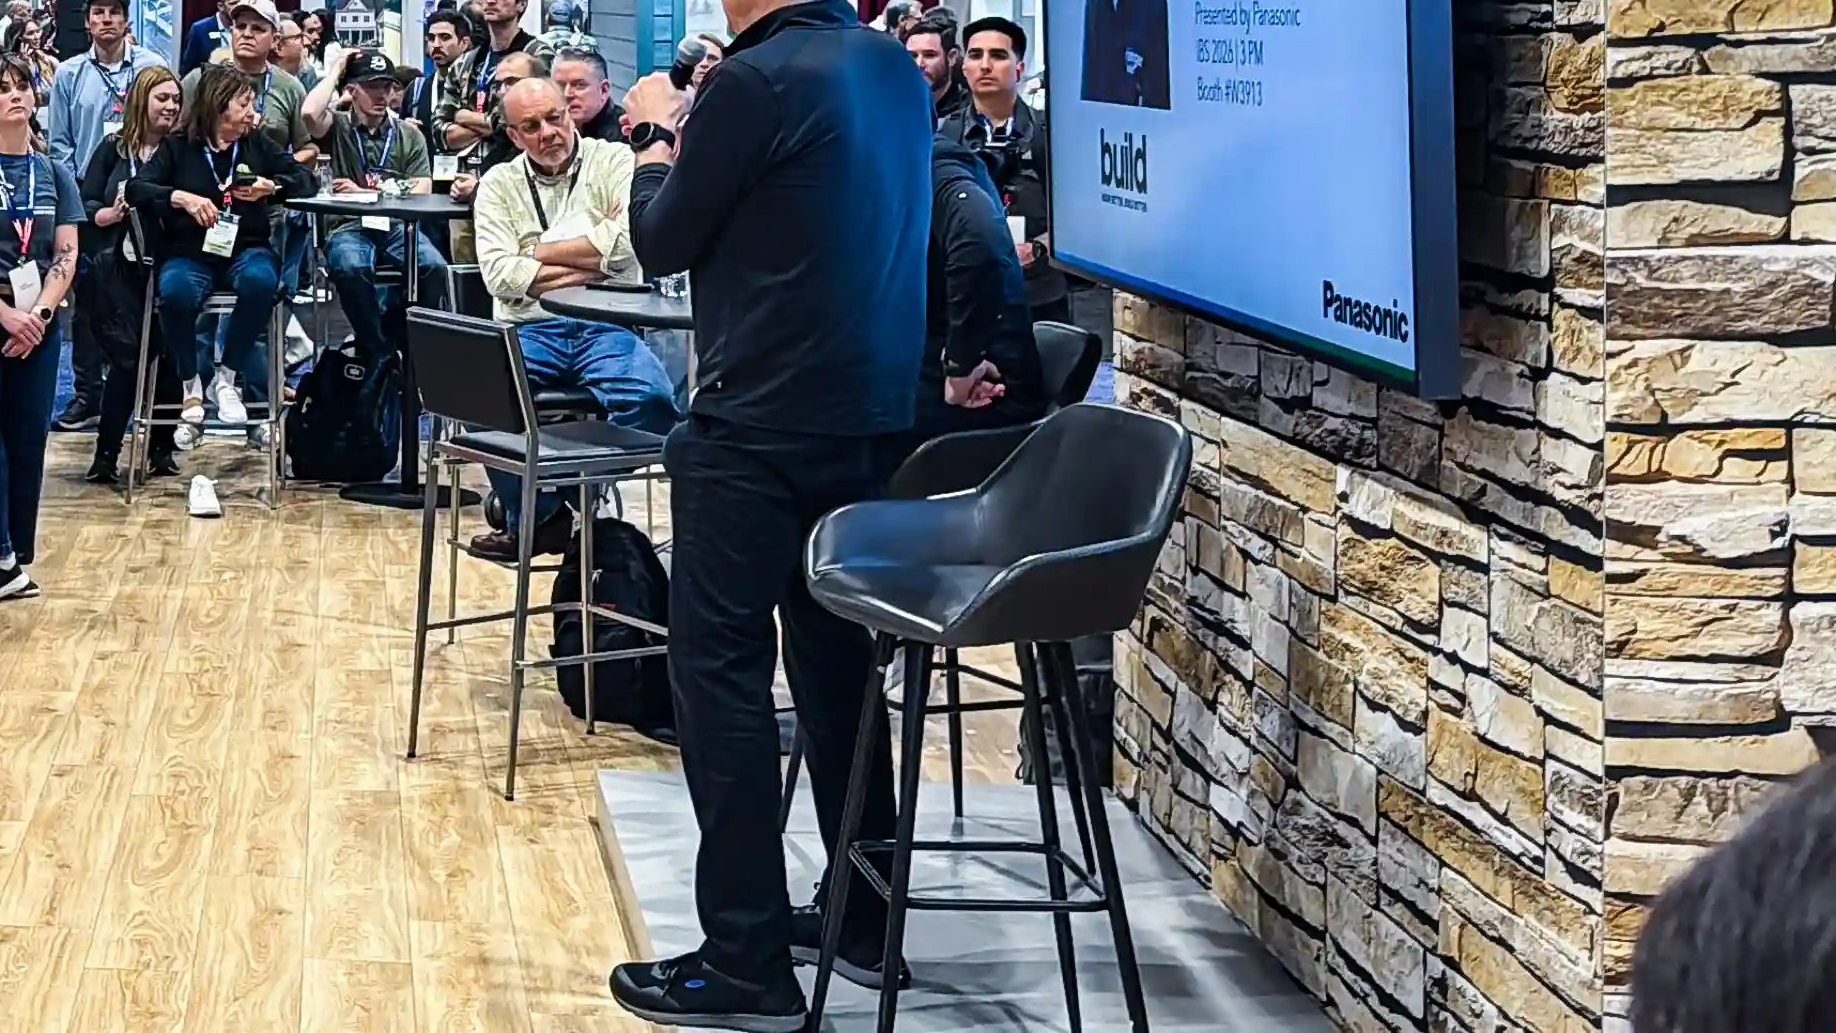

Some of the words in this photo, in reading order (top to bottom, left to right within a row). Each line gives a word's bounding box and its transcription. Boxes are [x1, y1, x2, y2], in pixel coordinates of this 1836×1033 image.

[1195, 0, 1238, 26] Presented
[1239, 0, 1251, 35] by
[1252, 0, 1301, 27] Panasonic
[1248, 39, 1264, 66] PM
[1197, 76, 1224, 102] Booth
[1100, 127, 1148, 195] build
[1323, 279, 1409, 344] Panasonic
